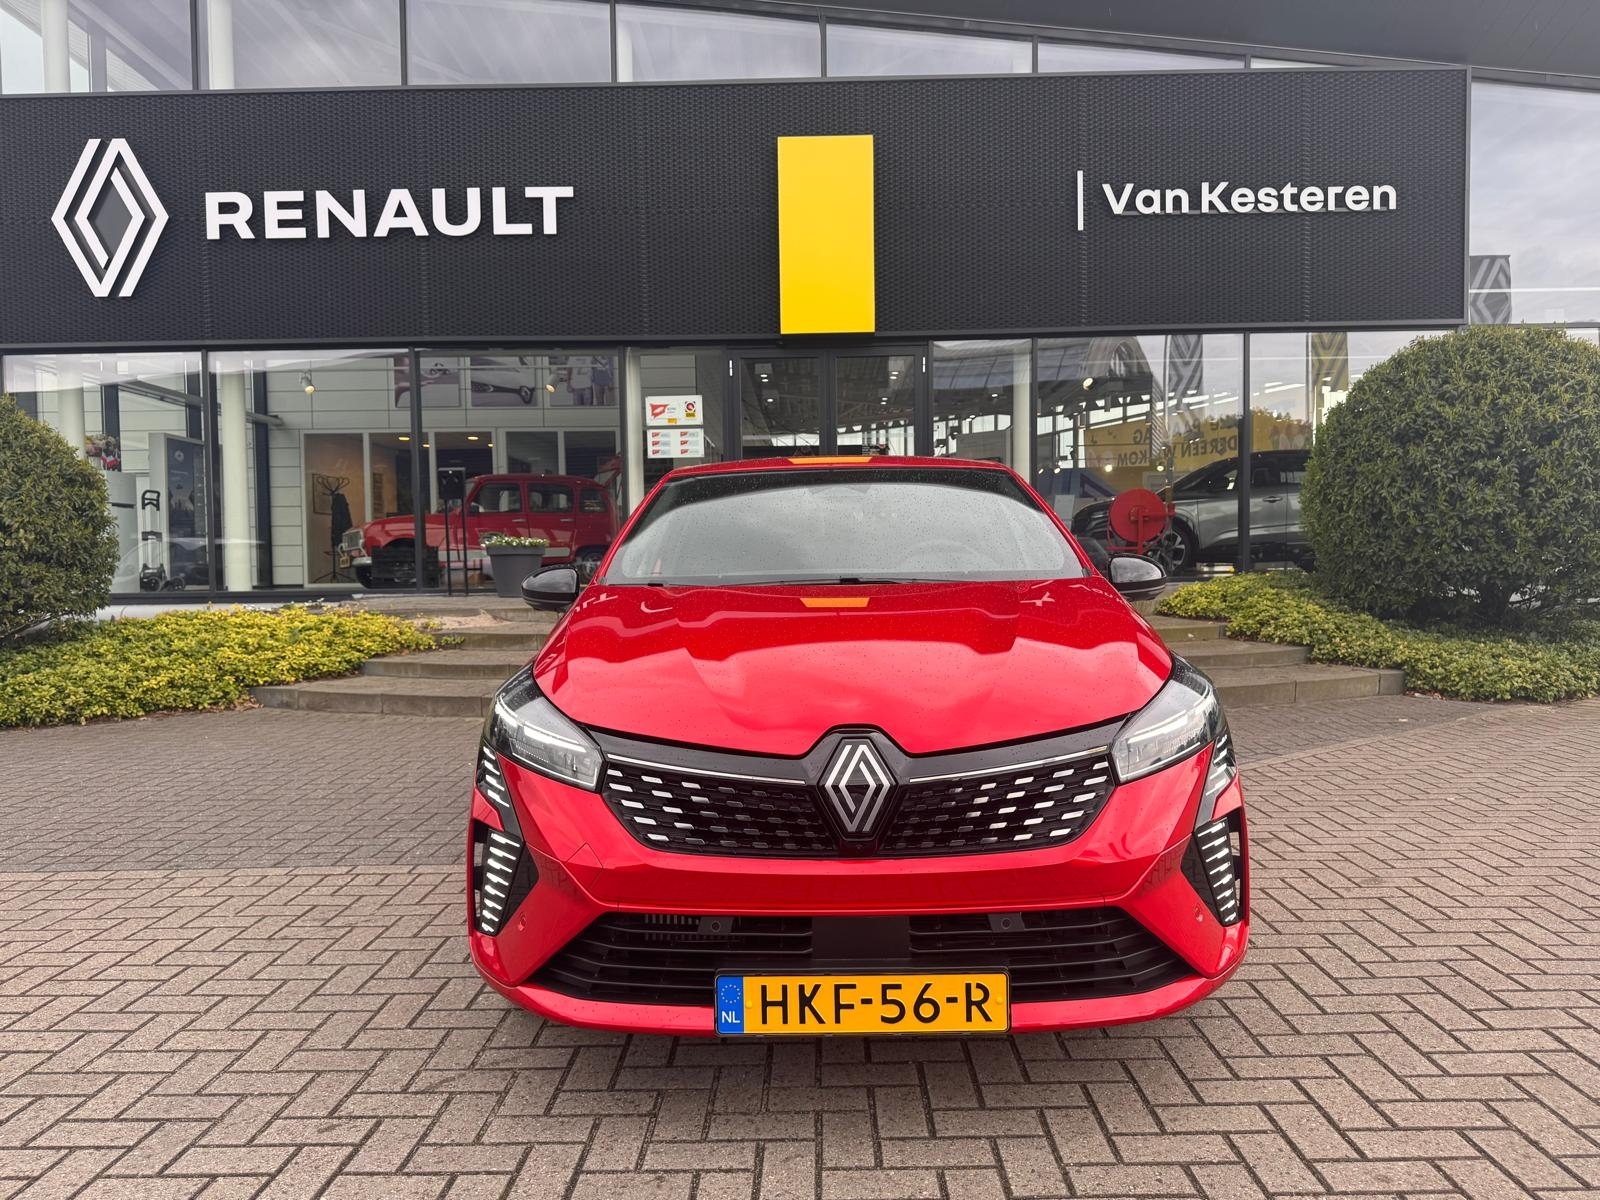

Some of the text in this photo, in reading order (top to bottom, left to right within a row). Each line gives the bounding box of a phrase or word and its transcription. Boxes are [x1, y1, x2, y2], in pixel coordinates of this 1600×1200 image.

[205, 186, 574, 240] RENAULT
[1102, 181, 1397, 214] Van Kesteren
[721, 1010, 741, 1024] NL
[760, 982, 993, 1025] HKF-56-R
